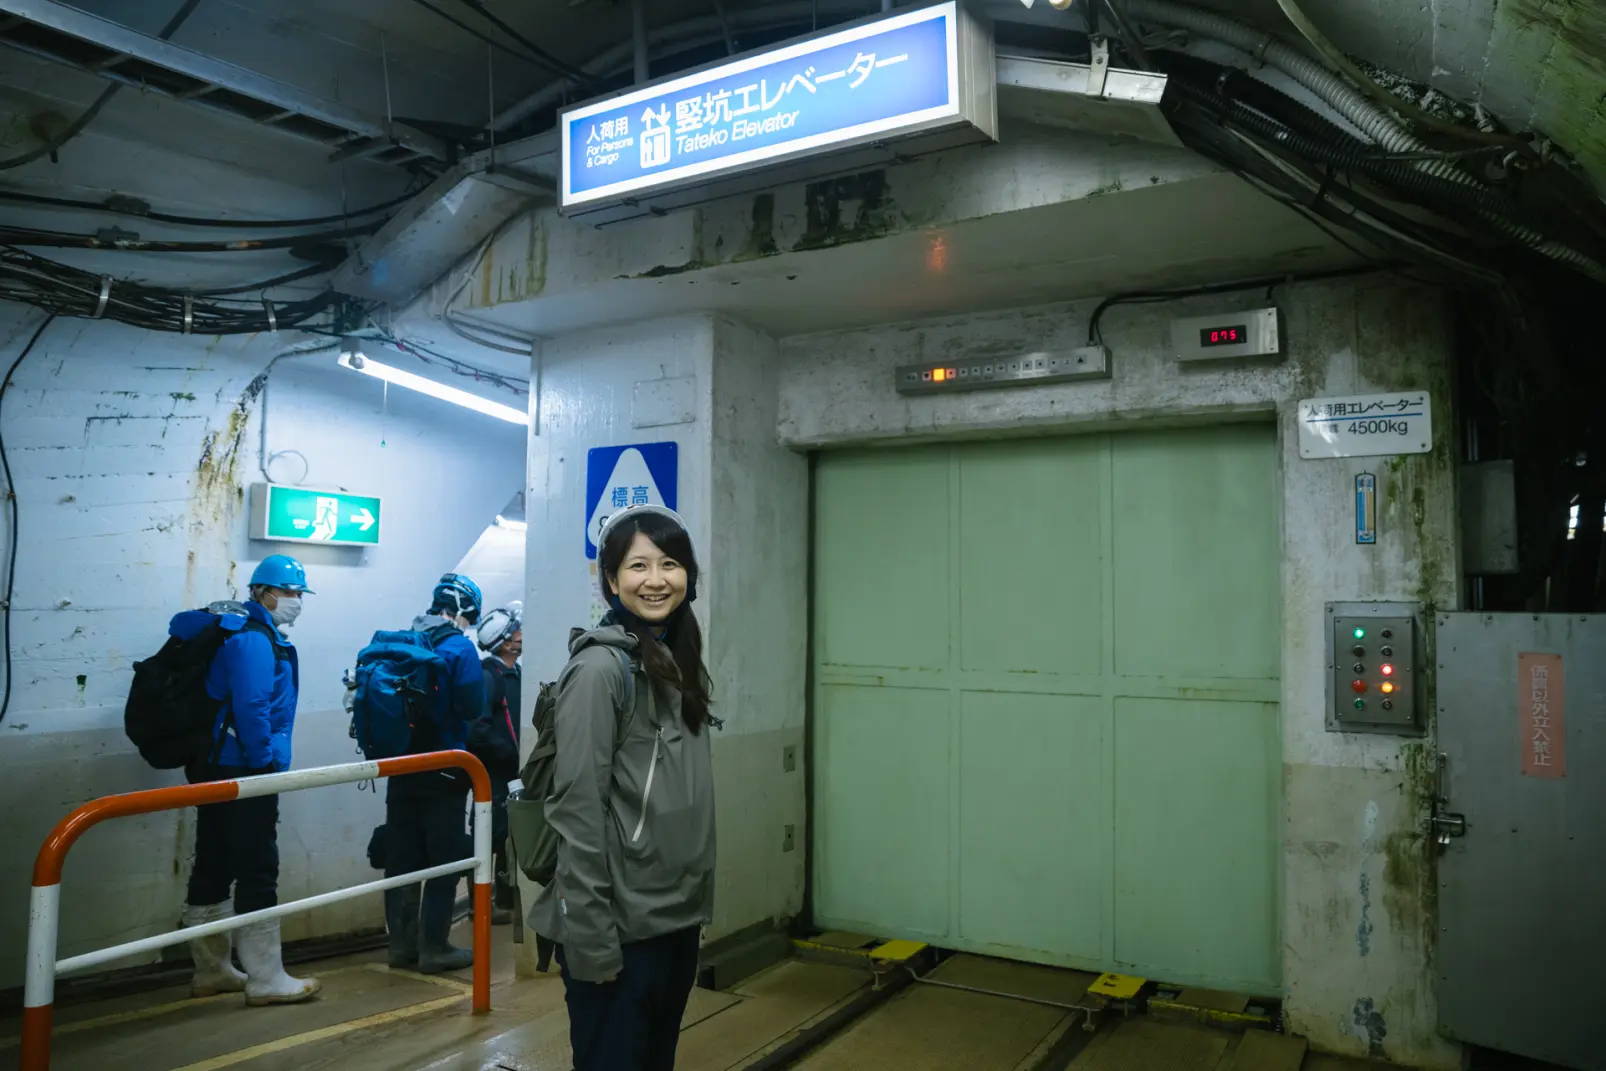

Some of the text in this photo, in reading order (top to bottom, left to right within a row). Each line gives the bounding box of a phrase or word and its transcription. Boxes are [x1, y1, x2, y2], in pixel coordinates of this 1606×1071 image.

[675, 52, 909, 134] 竪坑エレベーター
[586, 116, 629, 144] 人荷用
[676, 110, 801, 155] Tateko Elevator
[586, 145, 601, 157] For
[586, 152, 619, 168] & Cargo
[1348, 420, 1408, 435] 4500kg
[612, 485, 649, 508] 標高
